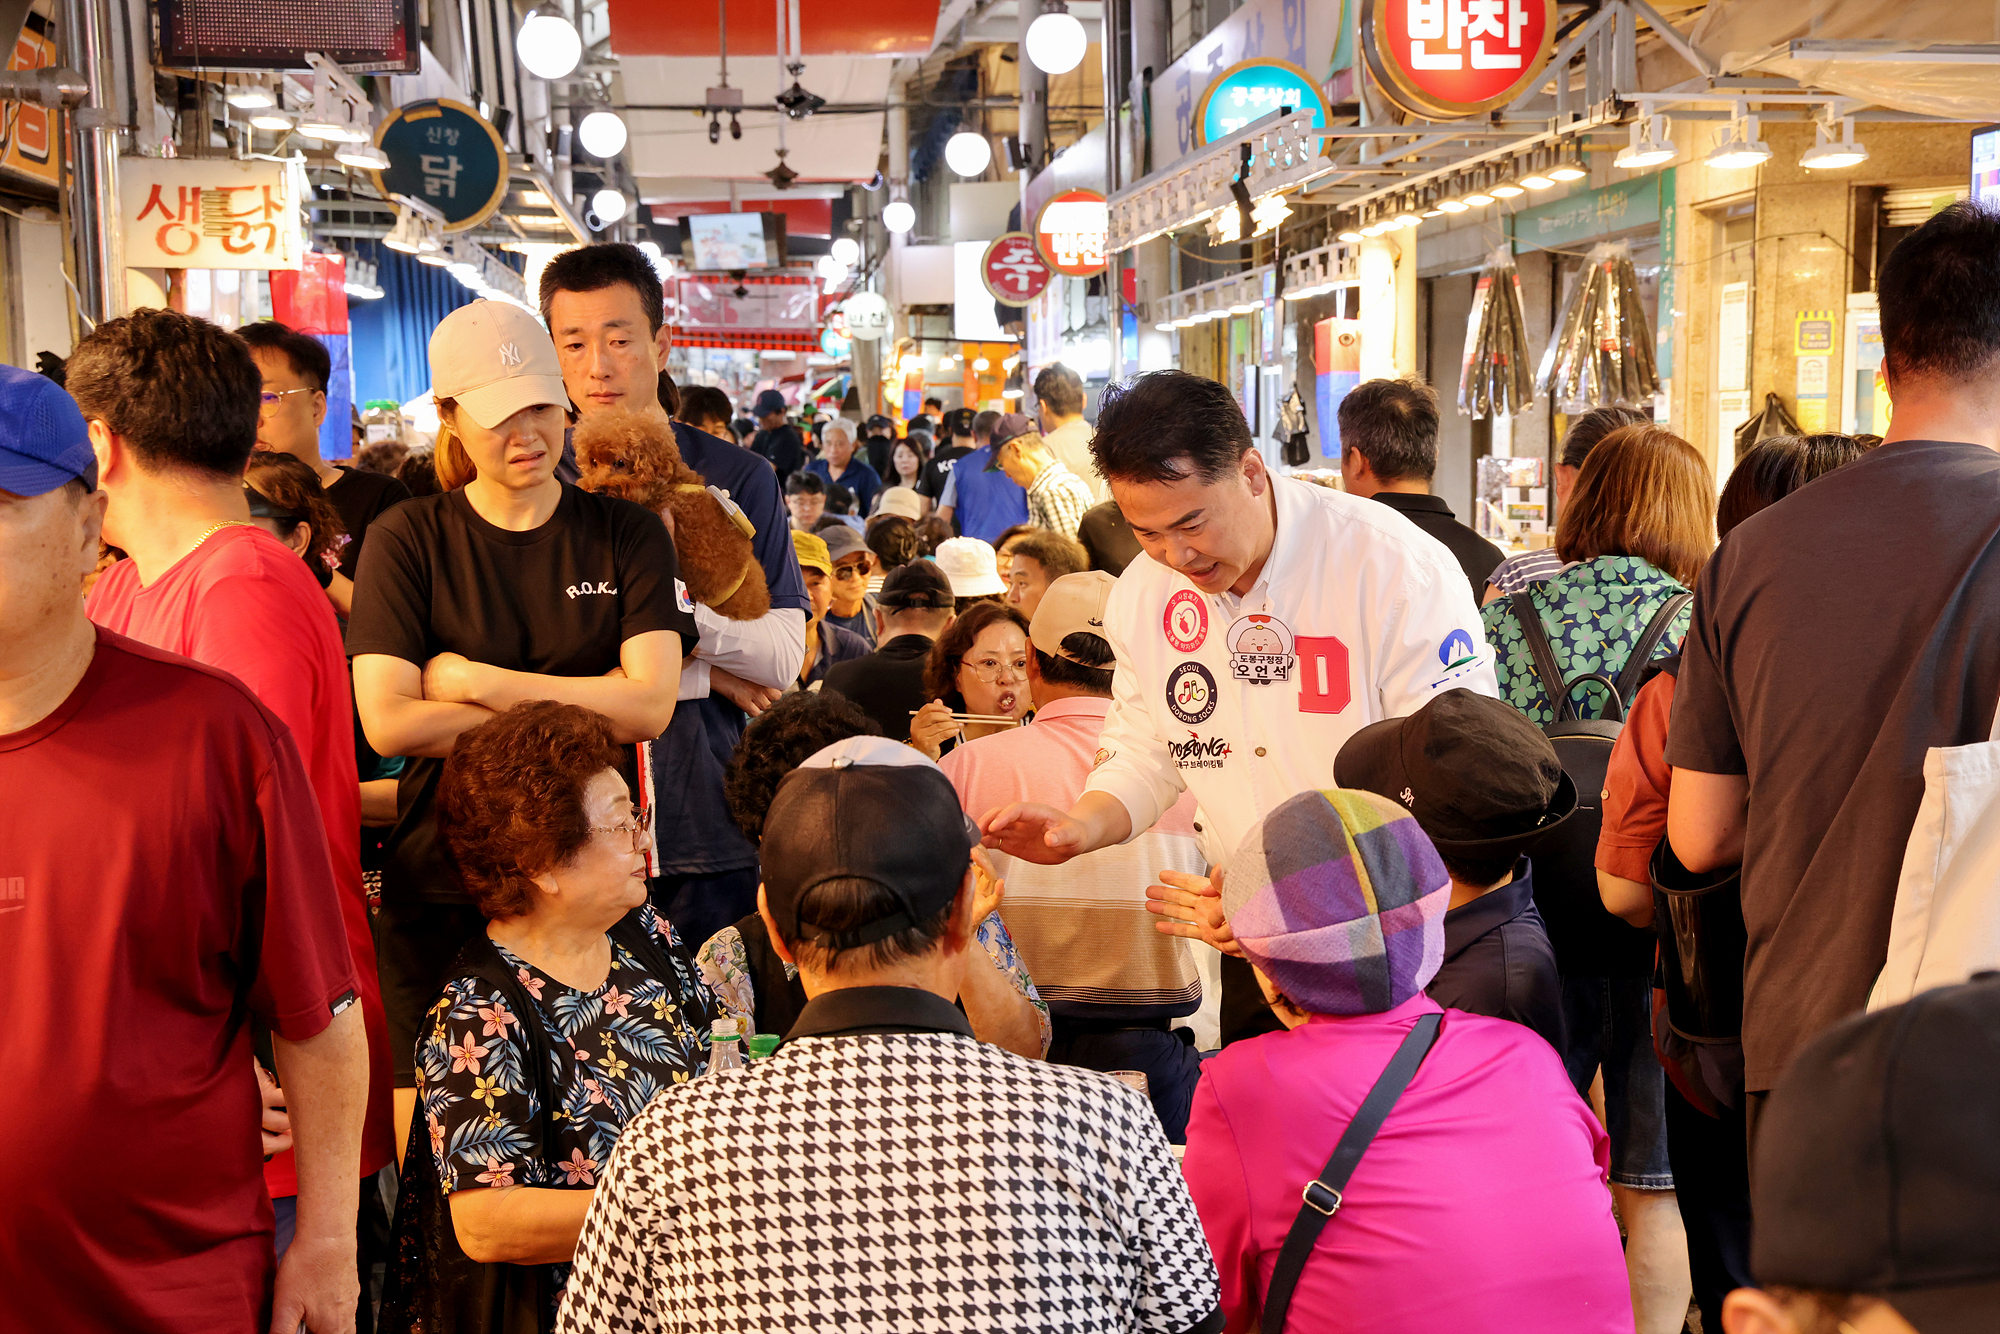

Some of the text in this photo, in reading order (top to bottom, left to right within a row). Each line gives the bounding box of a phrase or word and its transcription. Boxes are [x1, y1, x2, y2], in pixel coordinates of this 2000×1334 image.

[1407, 0, 1528, 70] 반찬
[1230, 87, 1301, 108] 공주상회
[420, 155, 463, 198] 닭
[136, 184, 284, 256] 생닭
[1052, 232, 1107, 266] 반찬
[991, 247, 1045, 292] 죽
[499, 342, 521, 366] NY
[1178, 664, 1201, 675] SEOUL
[1240, 655, 1284, 665] 도봉구청장
[1294, 636, 1351, 714] D
[1171, 700, 1216, 723] DOBONG SOCKS
[1167, 736, 1226, 760] DOBONG
[1190, 759, 1224, 769] 브레이킹팀
